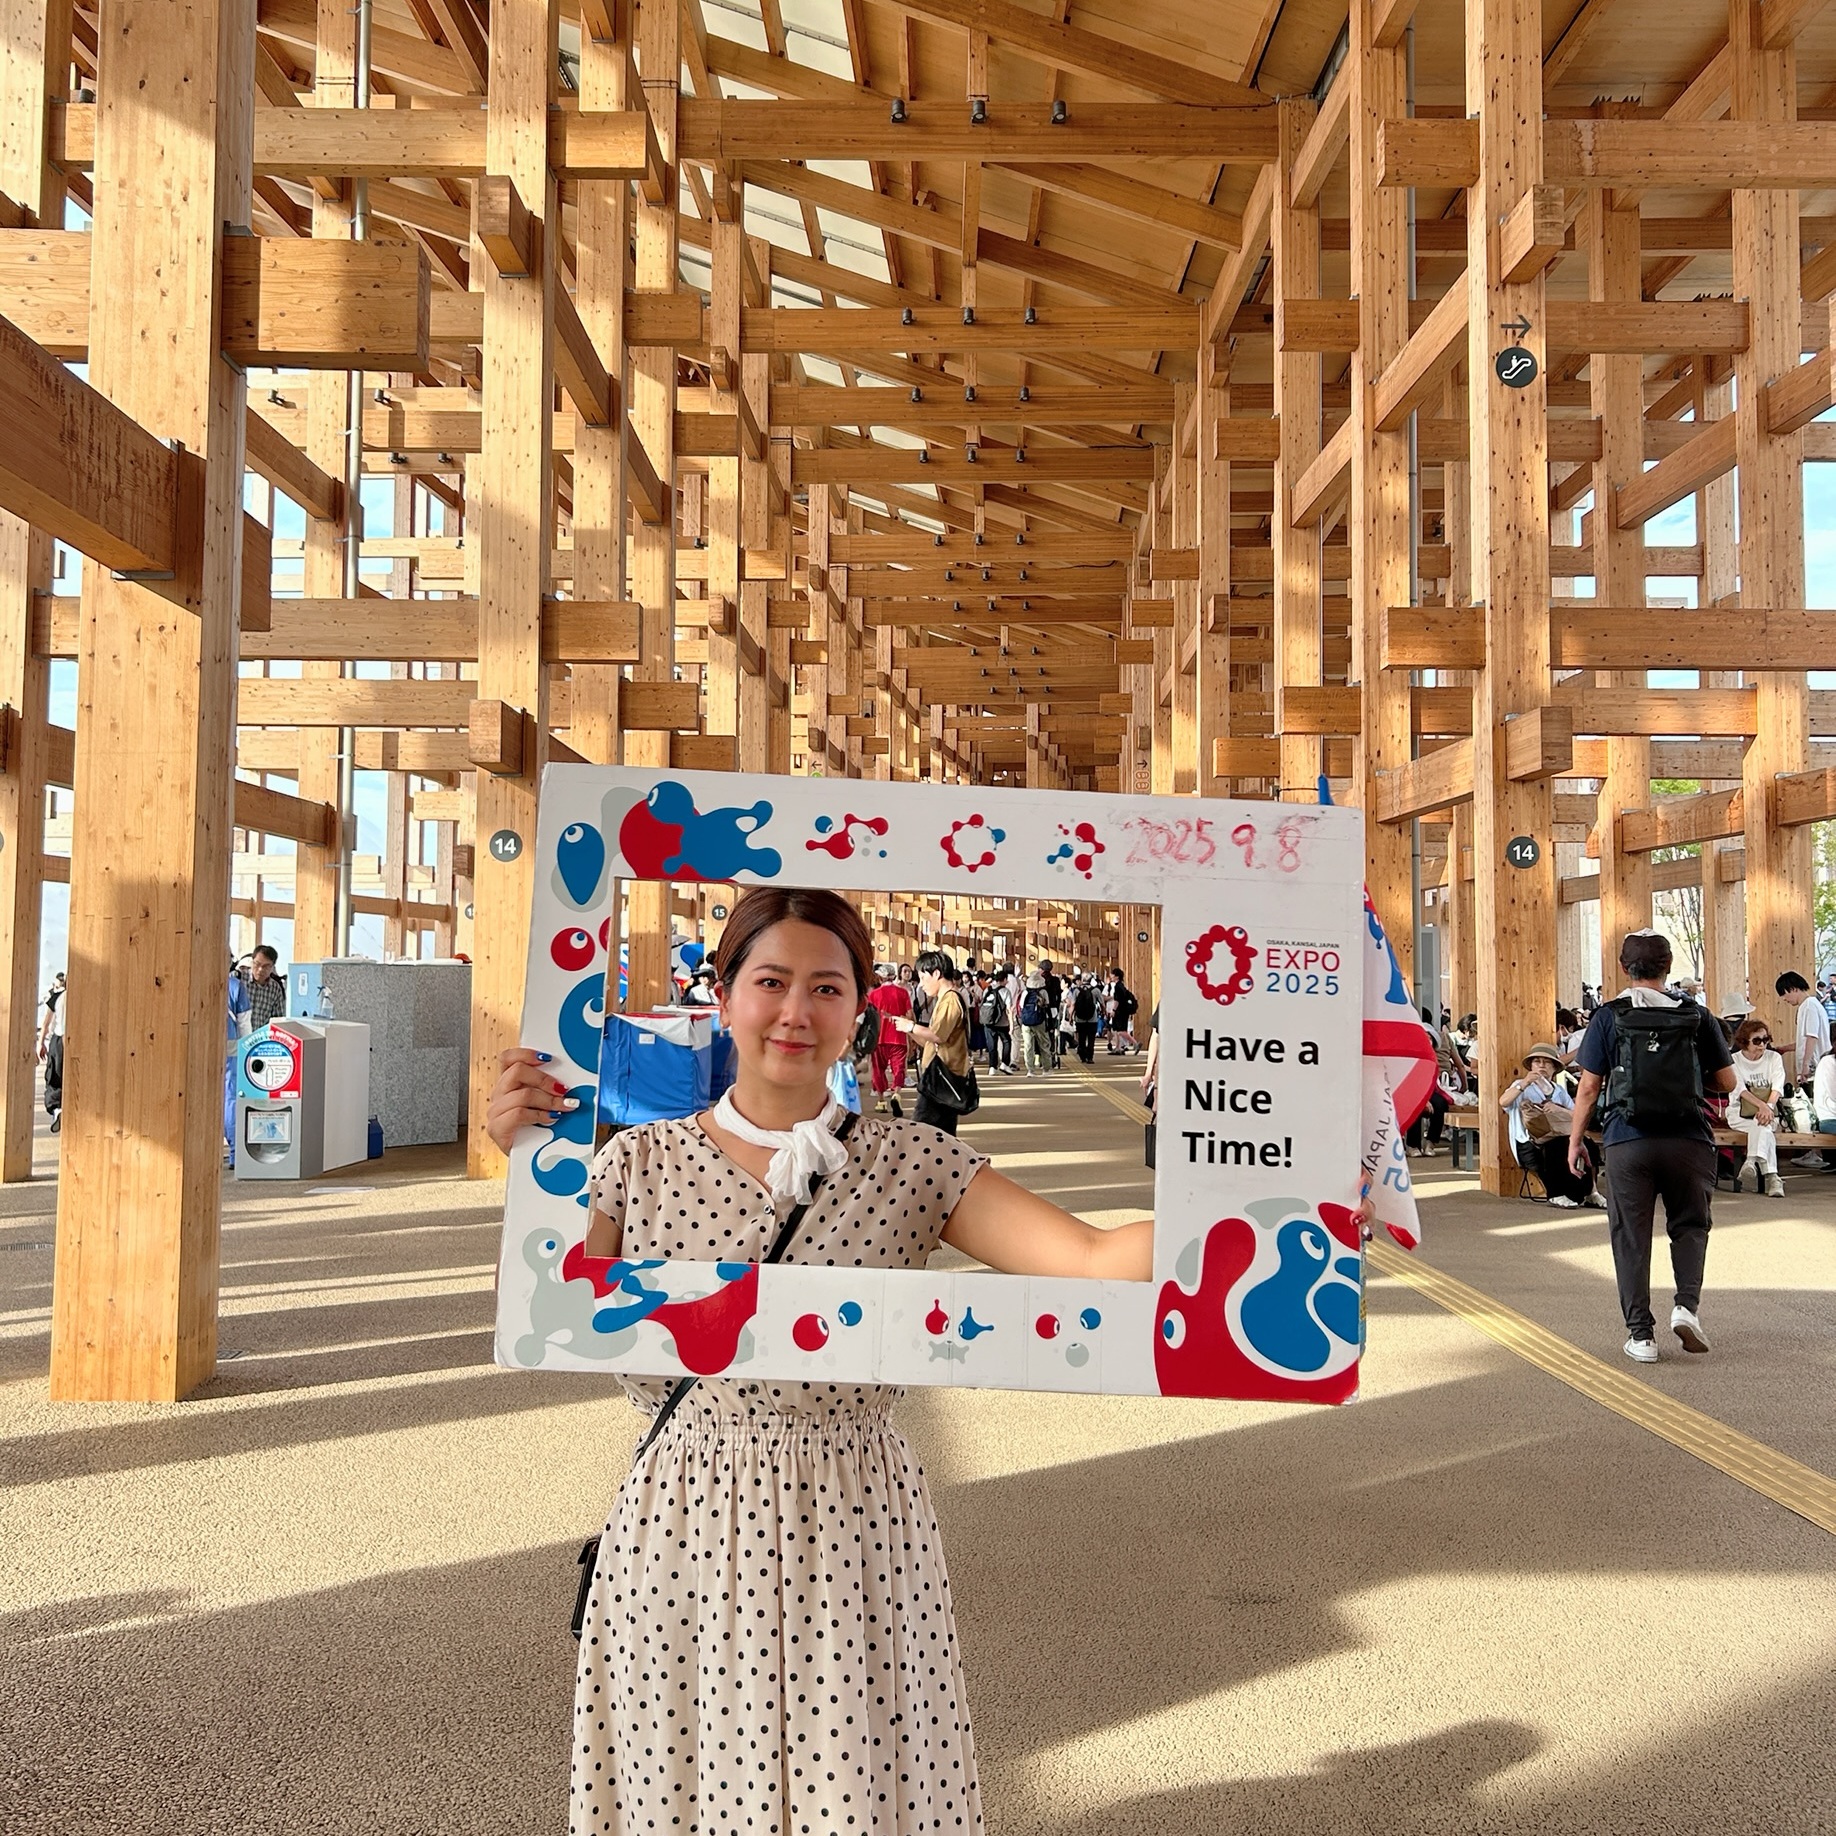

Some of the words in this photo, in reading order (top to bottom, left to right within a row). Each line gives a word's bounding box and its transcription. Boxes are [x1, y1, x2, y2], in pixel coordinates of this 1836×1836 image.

[495, 837, 517, 854] 14
[1512, 844, 1535, 861] 14
[714, 908, 725, 918] 15
[1266, 948, 1340, 972] EXPO
[1266, 972, 1340, 996] 2025
[1186, 1028, 1285, 1063] Have
[1298, 1041, 1319, 1065] a
[1185, 1079, 1272, 1114] Nice
[1181, 1131, 1292, 1168] Time!
